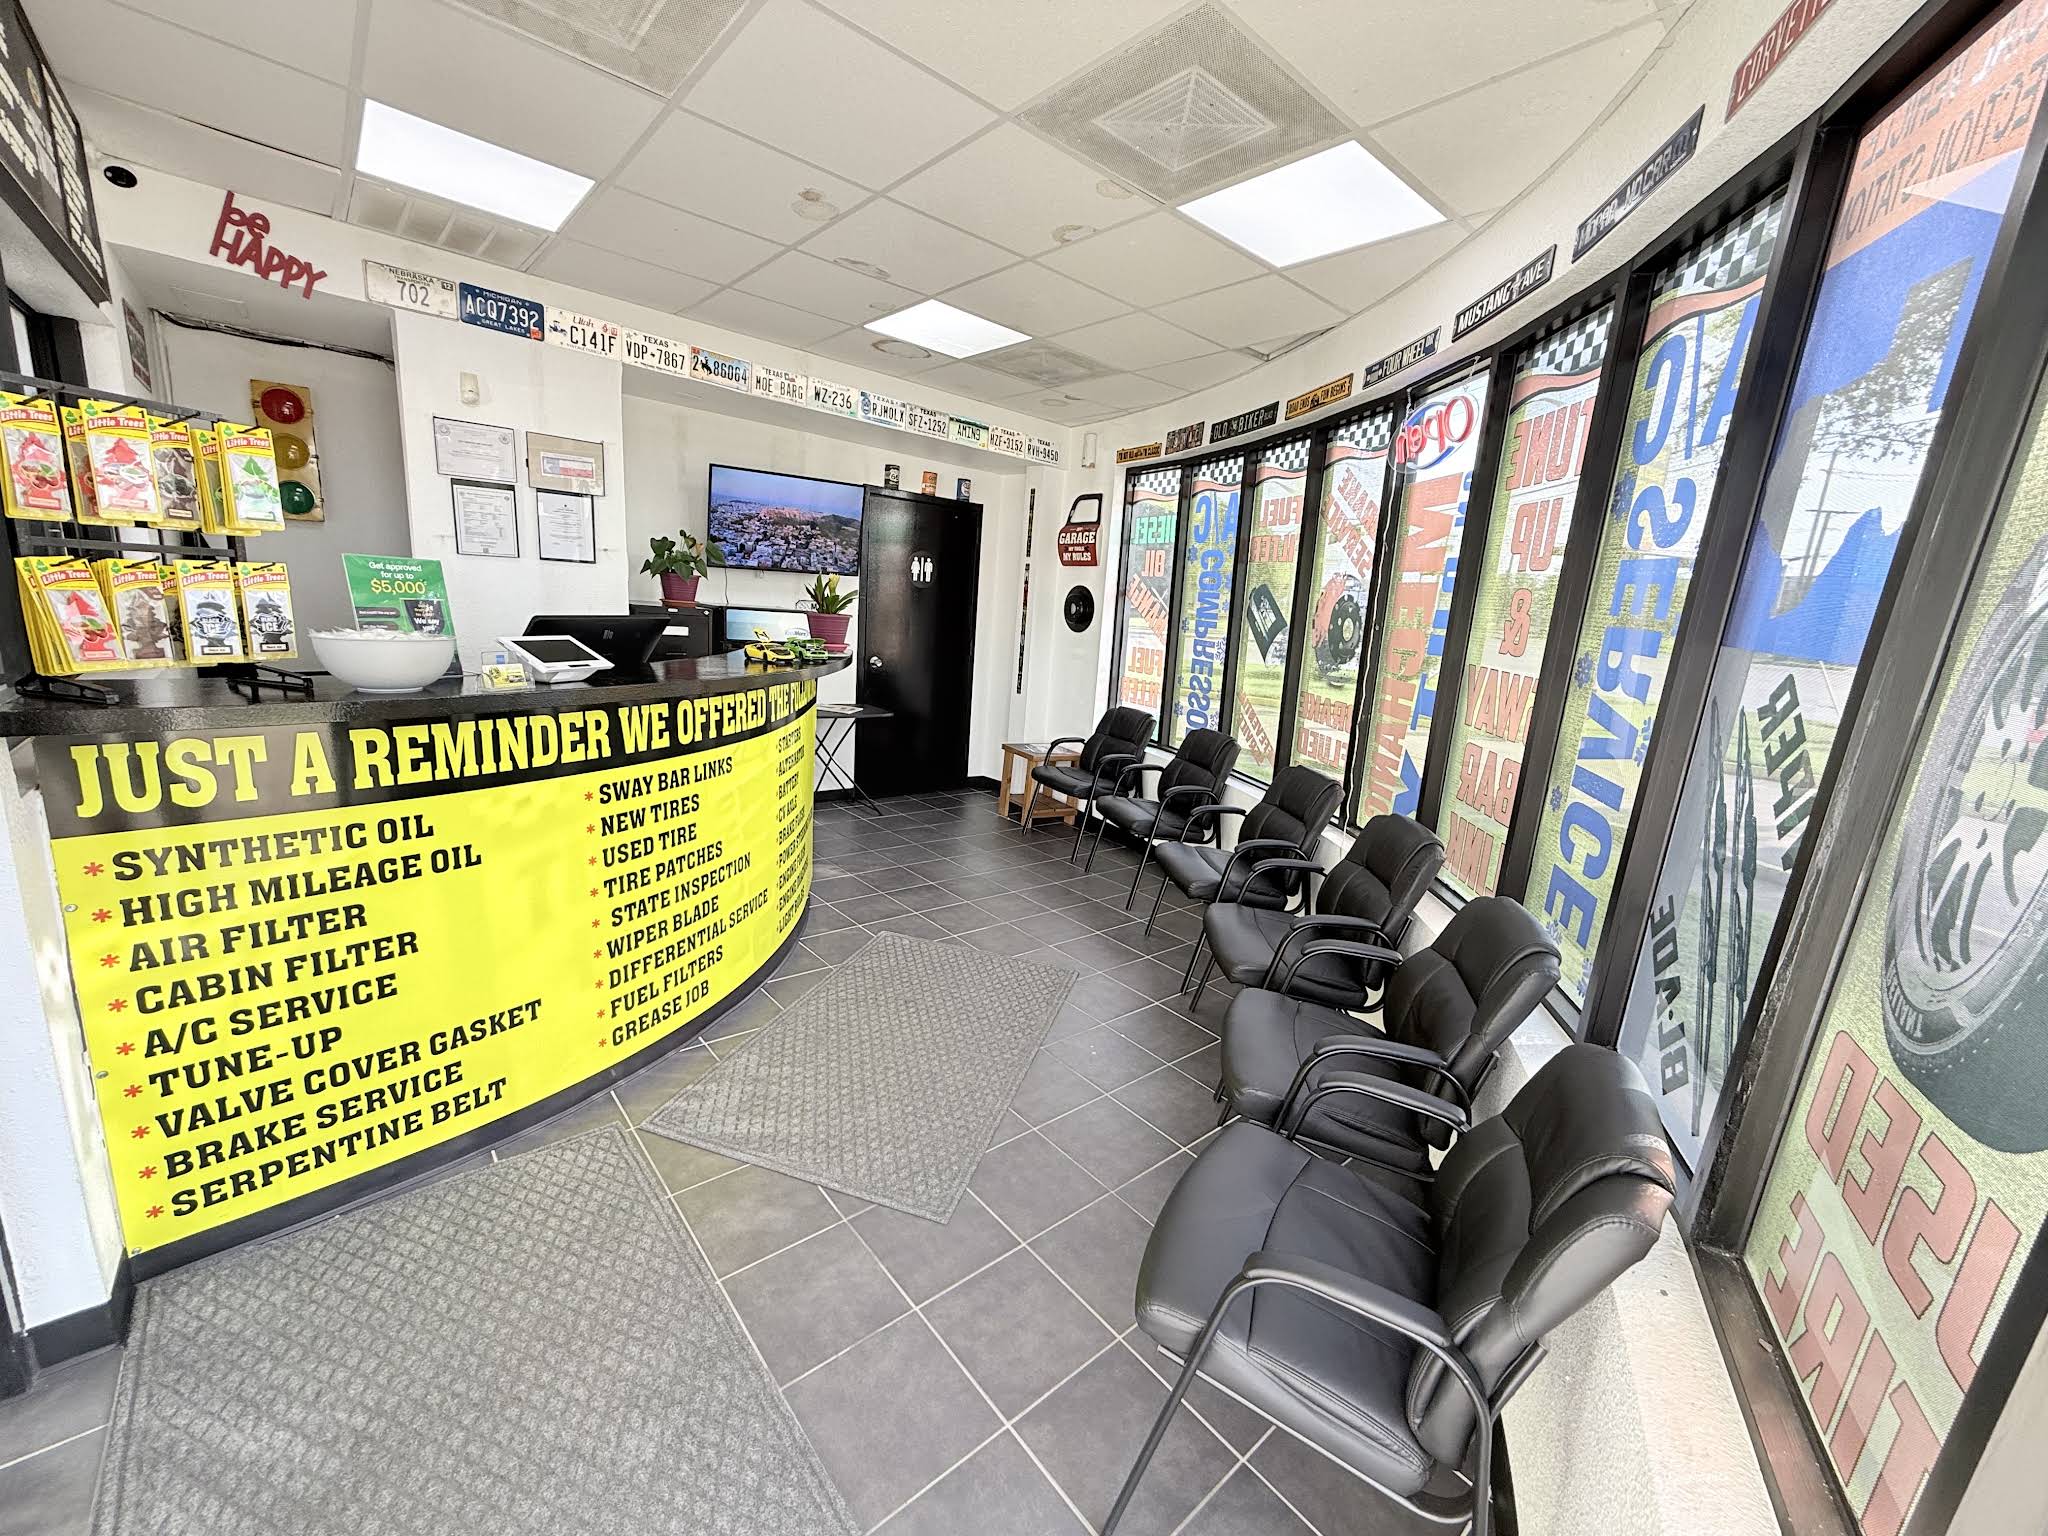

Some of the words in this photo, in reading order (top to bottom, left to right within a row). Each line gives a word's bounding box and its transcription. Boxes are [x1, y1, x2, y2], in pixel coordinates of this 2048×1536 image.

[1737, 0, 1827, 102] CORVET
[213, 190, 270, 240] be
[209, 216, 328, 299] HAPPY
[389, 267, 434, 284] NEBRASKA
[397, 280, 430, 307] 702
[483, 291, 522, 305] MICHIGAN
[1458, 284, 1511, 333] MUSTANG
[1521, 260, 1545, 291] AVE
[465, 294, 539, 331] ACQ7392
[481, 318, 501, 328] GREAT
[572, 316, 594, 328] Utah
[570, 325, 616, 354] C141F
[643, 334, 669, 349] TEXAS
[1382, 353, 1401, 377] FOUR
[1401, 339, 1426, 367] WHEEL
[692, 355, 699, 373] 2
[713, 360, 747, 385] 86064
[765, 368, 783, 379] TEXAS
[0, 411, 27, 422] Little
[30, 411, 54, 421] Trees
[89, 419, 116, 429] Little
[119, 418, 146, 428] Trees
[920, 406, 937, 418] TEXAS
[1213, 423, 1228, 440] OLD
[1238, 409, 1264, 433] BIKER
[226, 438, 247, 448] Little
[248, 439, 270, 447] Trees
[1059, 531, 1096, 545] GARAGE
[1063, 553, 1072, 561] MY
[1072, 552, 1092, 561] RULES
[42, 572, 67, 585] Little
[68, 571, 92, 580] Trees
[114, 574, 136, 586] Little
[137, 572, 158, 581] Trees
[183, 574, 206, 585] Little
[207, 572, 229, 580] Trees
[244, 575, 264, 586] Little
[265, 574, 286, 582] Trees
[368, 561, 385, 570] Get
[385, 563, 422, 572] approved
[380, 570, 393, 579] for
[394, 572, 405, 580] up
[405, 572, 415, 580] to
[203, 622, 221, 633] ICE
[261, 622, 279, 632] ICE
[70, 734, 268, 818] JUST
[291, 731, 337, 797] A
[349, 709, 612, 790] REMINDER
[617, 702, 672, 756] WE
[676, 688, 767, 745] OFFERED
[768, 683, 790, 723] THE
[599, 774, 654, 805] SWAY
[657, 766, 691, 793] BAR
[693, 755, 734, 784] LINKS
[600, 806, 647, 837] NEW
[649, 792, 701, 824] TIRES
[113, 821, 368, 881] SYNTHETIC
[377, 813, 435, 845] OIL
[601, 835, 655, 869] USED
[657, 821, 698, 852] TIRE
[119, 883, 238, 927] HIGH
[250, 853, 423, 905] MILEAGE
[430, 844, 483, 874] OIL
[602, 866, 652, 899] TIRE
[654, 839, 724, 883] PATCHES
[610, 888, 672, 929] STATE
[673, 851, 752, 904] INSPECTION
[129, 933, 210, 972] AIR
[219, 902, 369, 955] FILTER
[605, 918, 670, 960] WIPER
[672, 894, 720, 933] BLADE
[608, 917, 727, 990] DIFFERENTIAL
[728, 887, 769, 929] SERVICE
[134, 961, 275, 1015] CABIN
[285, 930, 420, 984] FILTER
[609, 980, 661, 1019] FUEL
[662, 943, 724, 993] FILTERS
[144, 1016, 218, 1059] A/C
[229, 972, 400, 1037] SERVICE
[611, 994, 683, 1047] GREASE
[684, 978, 710, 1009] JOB
[148, 1025, 344, 1099] TUNE-UP
[154, 1075, 295, 1140] VALVE
[303, 1041, 423, 1097] COVER
[429, 999, 543, 1057] GASKET
[163, 1116, 308, 1181] BRAKE
[316, 1060, 465, 1130] SERVICE
[171, 1108, 424, 1218] SERPENTINE
[431, 1077, 509, 1126] BELT
